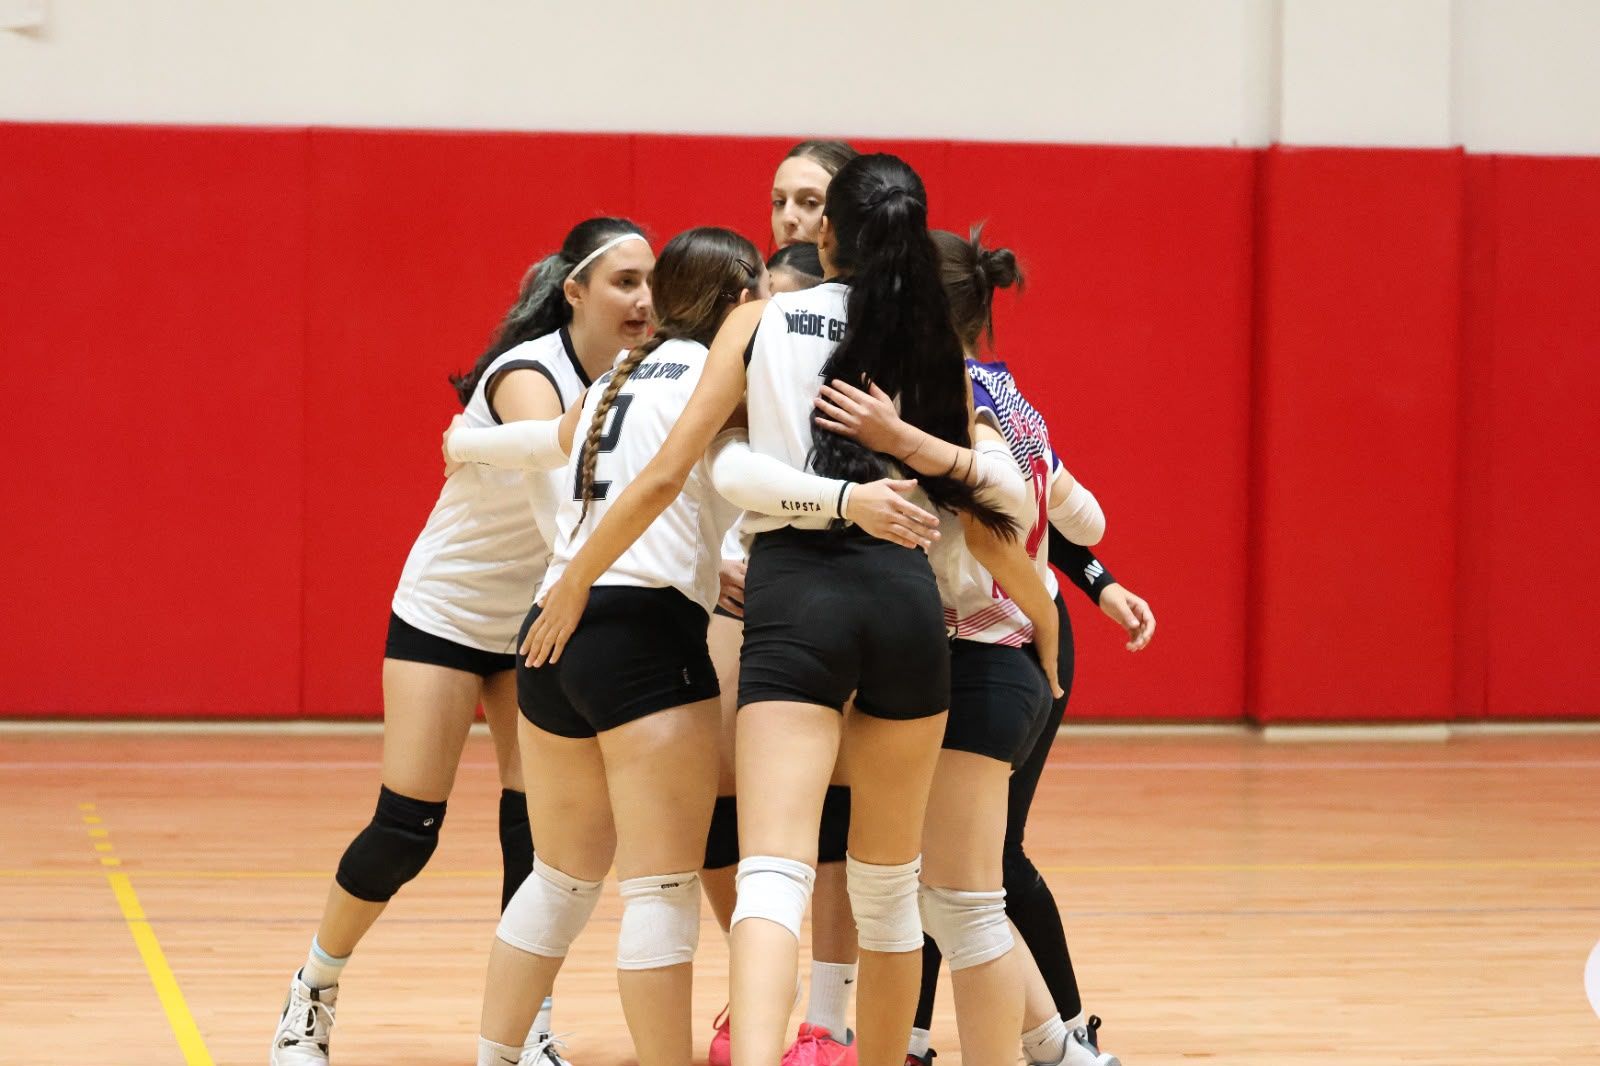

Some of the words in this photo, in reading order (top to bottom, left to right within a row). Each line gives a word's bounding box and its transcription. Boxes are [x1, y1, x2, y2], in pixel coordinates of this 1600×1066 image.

[784, 309, 826, 338] NİĞDE
[654, 362, 690, 380] SPOR
[573, 393, 635, 501] 2
[781, 500, 821, 512] KIPSTA
